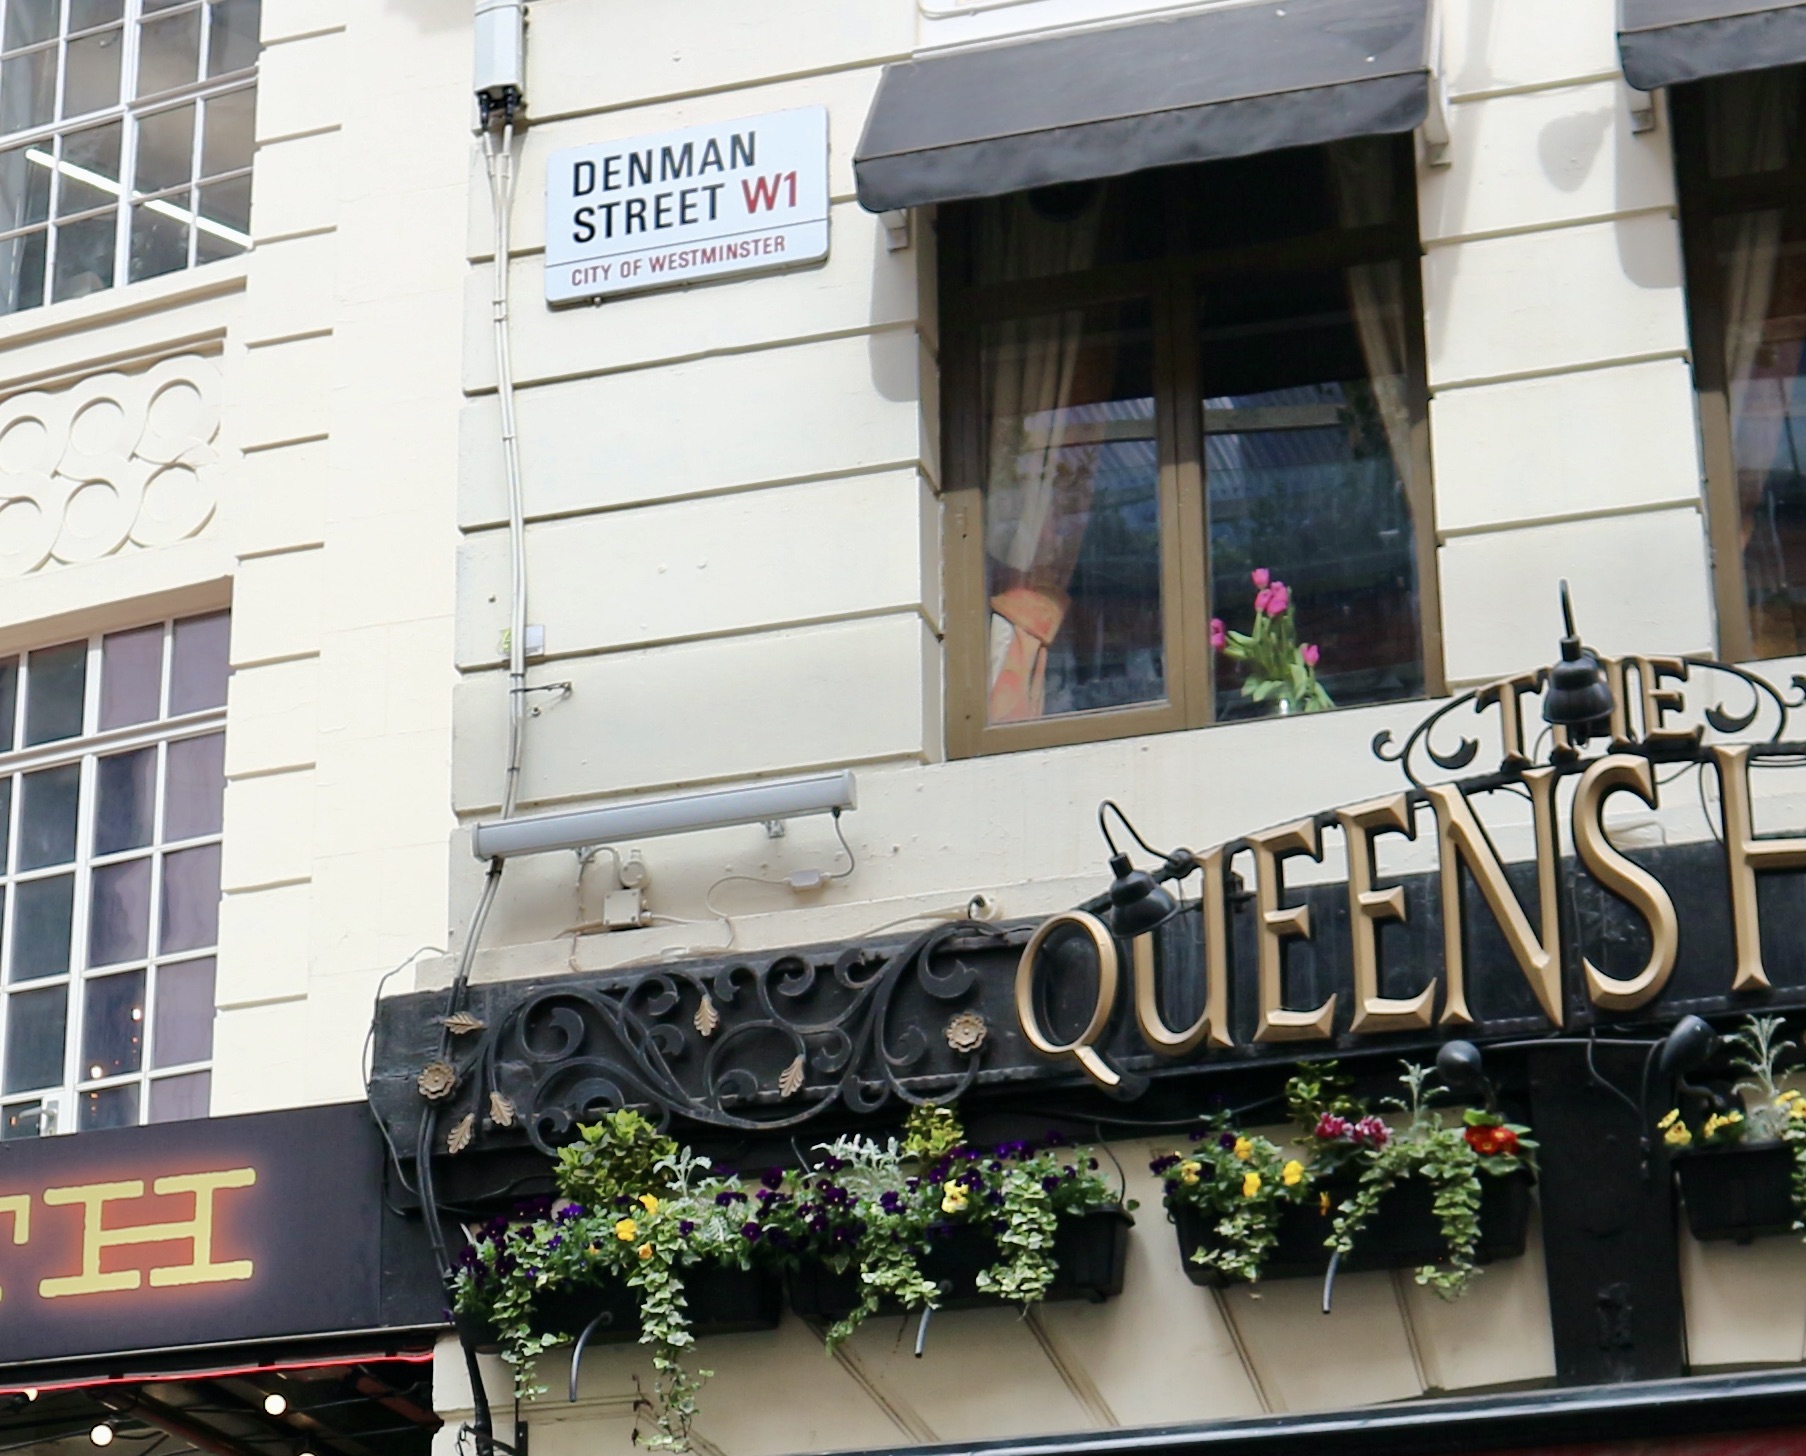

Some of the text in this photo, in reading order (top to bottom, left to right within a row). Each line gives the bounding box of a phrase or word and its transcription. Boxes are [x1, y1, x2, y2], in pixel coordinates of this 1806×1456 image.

[573, 131, 757, 198] DENMAN
[573, 170, 798, 243] STREET W1
[571, 235, 786, 287] CITY OF WESTMINSTER
[1013, 753, 1682, 1098] QUEENS
